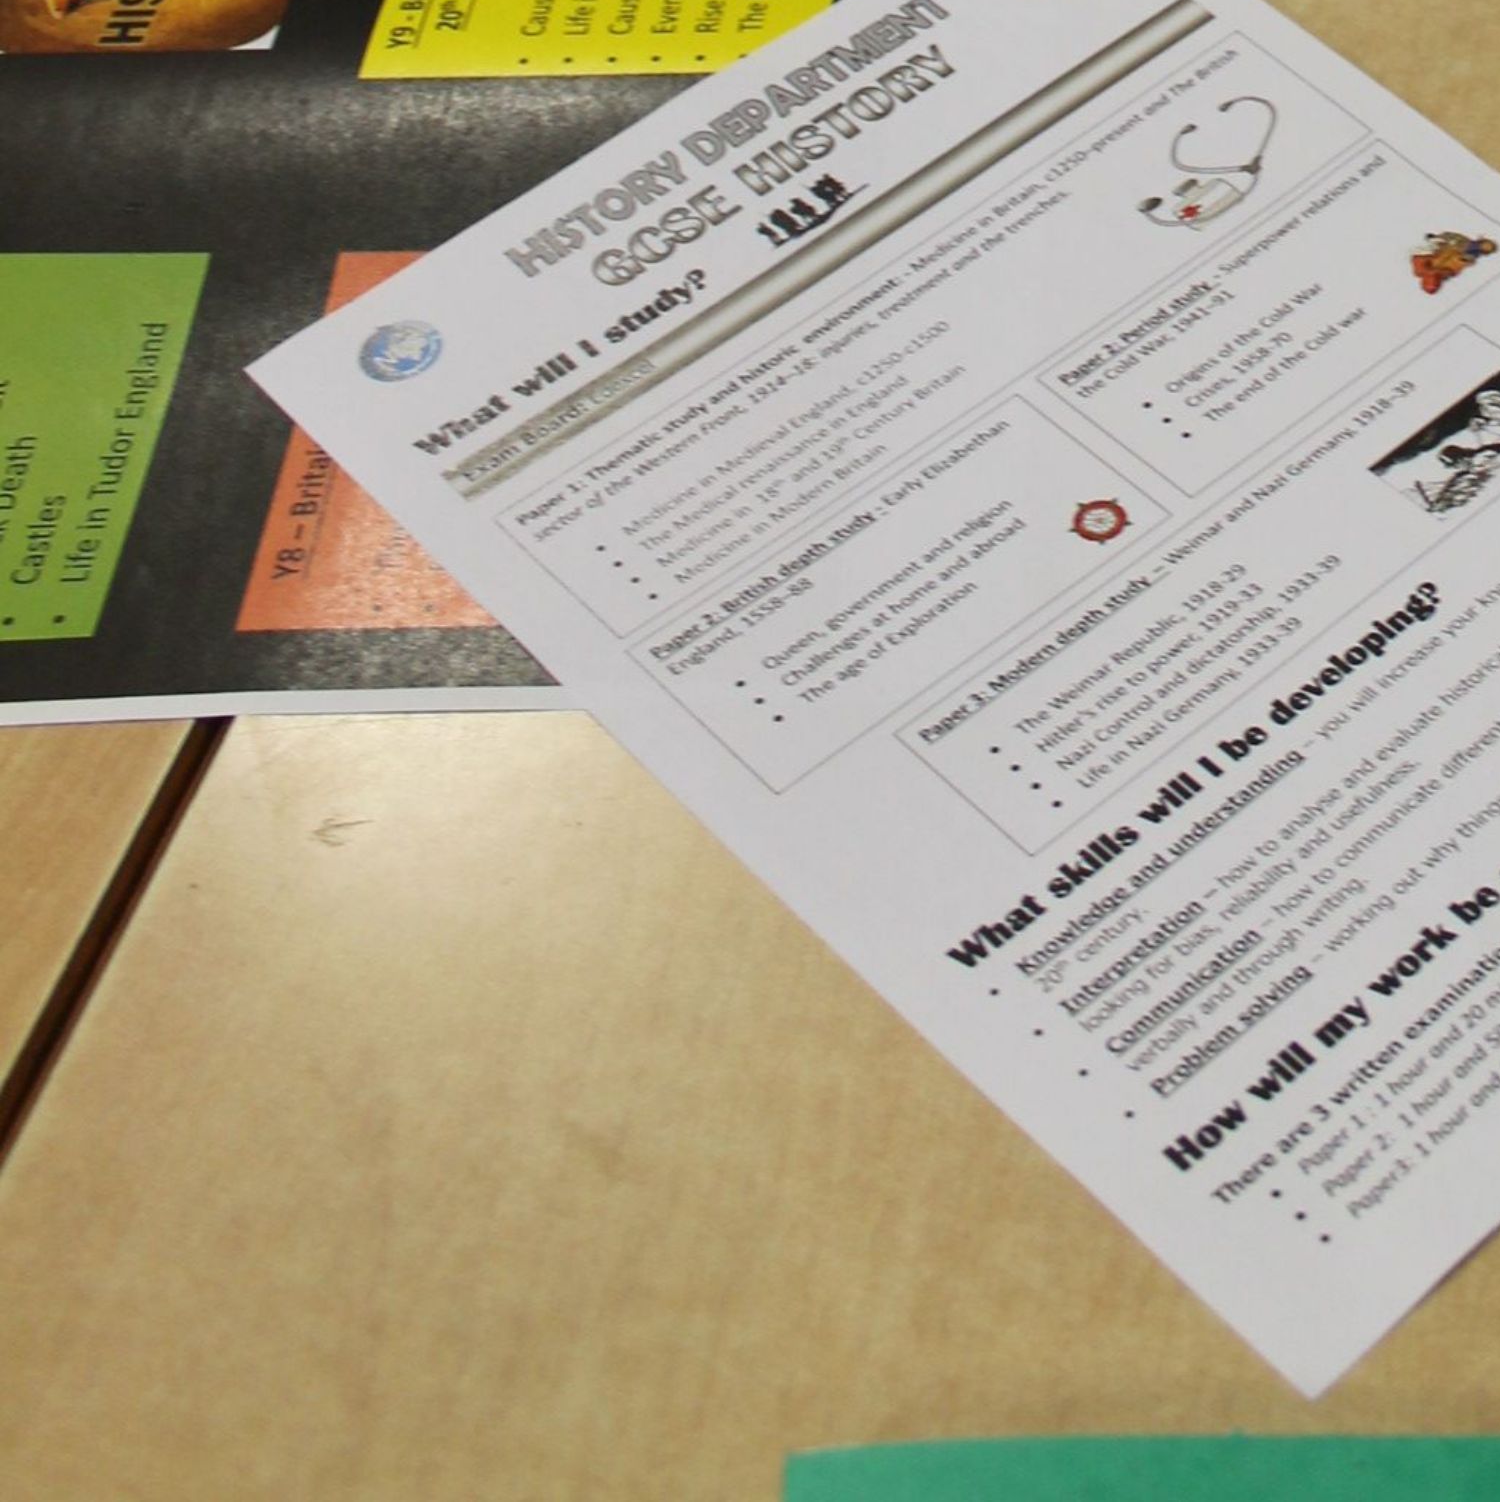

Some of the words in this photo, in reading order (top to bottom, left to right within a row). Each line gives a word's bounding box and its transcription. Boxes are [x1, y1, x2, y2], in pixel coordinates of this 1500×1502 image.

[387, 27, 415, 49] Y9
[436, 0, 463, 30] 20th
[563, 5, 596, 36] Life
[694, 0, 726, 34] Rise
[738, 1, 769, 33] The
[591, 183, 744, 287] GCSE
[731, 43, 956, 197] HISTORY
[502, 149, 689, 278] HISTORY
[115, 323, 169, 420] England
[411, 394, 511, 455] What
[510, 352, 578, 397] will
[576, 338, 601, 358] I
[603, 268, 706, 344] study?
[87, 427, 137, 495] Tudor
[461, 440, 525, 485] Exam
[518, 398, 590, 448] Board:
[10, 495, 67, 586] Castles
[60, 539, 101, 583] Life
[75, 507, 111, 530] in
[271, 548, 306, 580] Y8
[917, 704, 975, 744] Paper
[967, 691, 997, 713] 3:
[986, 643, 1062, 694] Modern
[1055, 609, 1110, 646] depth
[1103, 575, 1153, 613] study
[1161, 520, 1225, 565] Weimar
[1224, 496, 1256, 523] and
[1250, 474, 1290, 501] Nazi
[1284, 427, 1359, 477] Germany,
[945, 894, 1047, 968] What
[1047, 825, 1140, 899] skills
[1136, 771, 1204, 824] will
[1196, 755, 1225, 778] I
[1216, 726, 1268, 762] be
[1268, 581, 1440, 726] developing?
[1161, 1100, 1247, 1172] How
[1246, 1040, 1317, 1101] will
[1313, 996, 1370, 1049] my
[1367, 925, 1459, 997] work
[1447, 886, 1500, 925] be
[1210, 1152, 1277, 1204] There
[1276, 1121, 1314, 1155] are
[1309, 1103, 1331, 1122] 3
[1328, 1040, 1406, 1105] written
